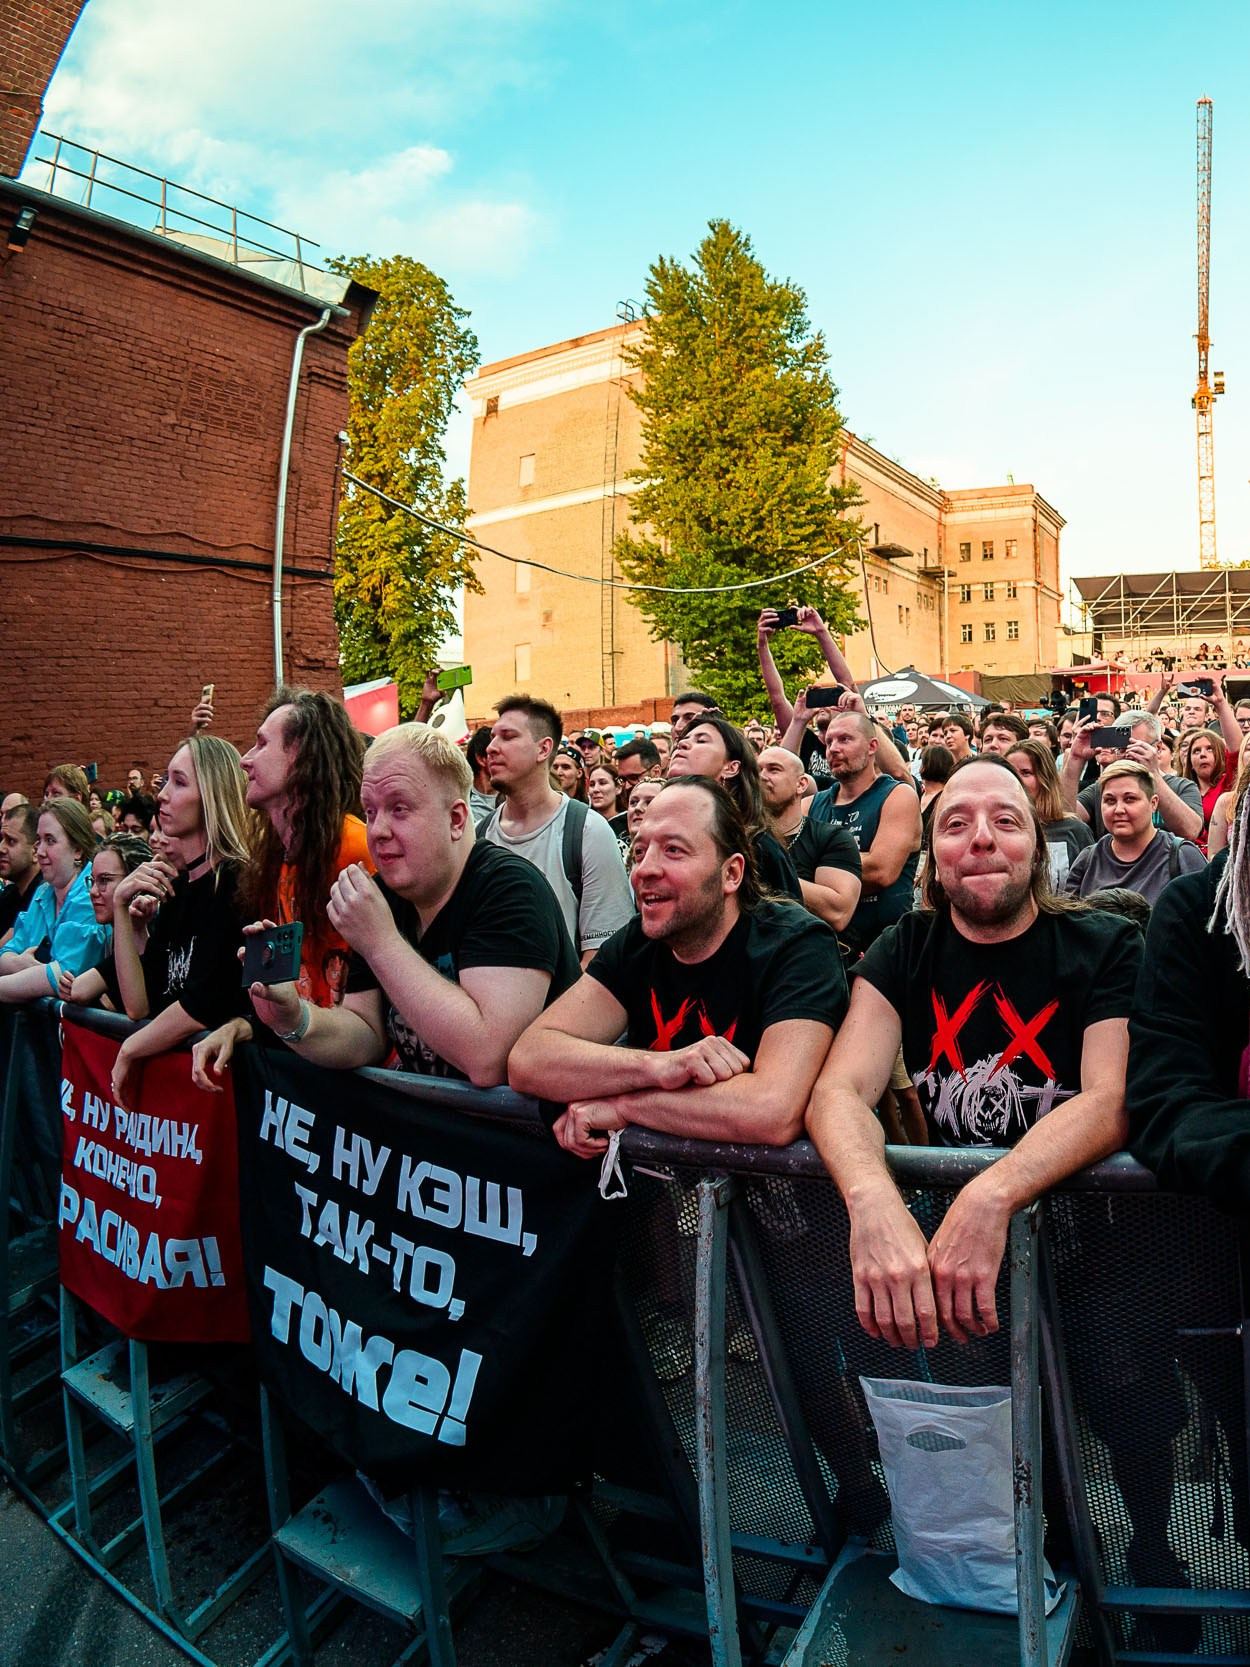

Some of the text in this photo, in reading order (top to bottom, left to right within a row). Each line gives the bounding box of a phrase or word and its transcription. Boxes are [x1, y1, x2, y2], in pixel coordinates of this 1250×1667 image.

[82, 1091, 110, 1132] НУ
[259, 1090, 538, 1257] НЕ, НУ КЭШ,
[59, 1173, 226, 1289] РАСИВАЯ!
[294, 1181, 466, 1321] ТАК-ТО,
